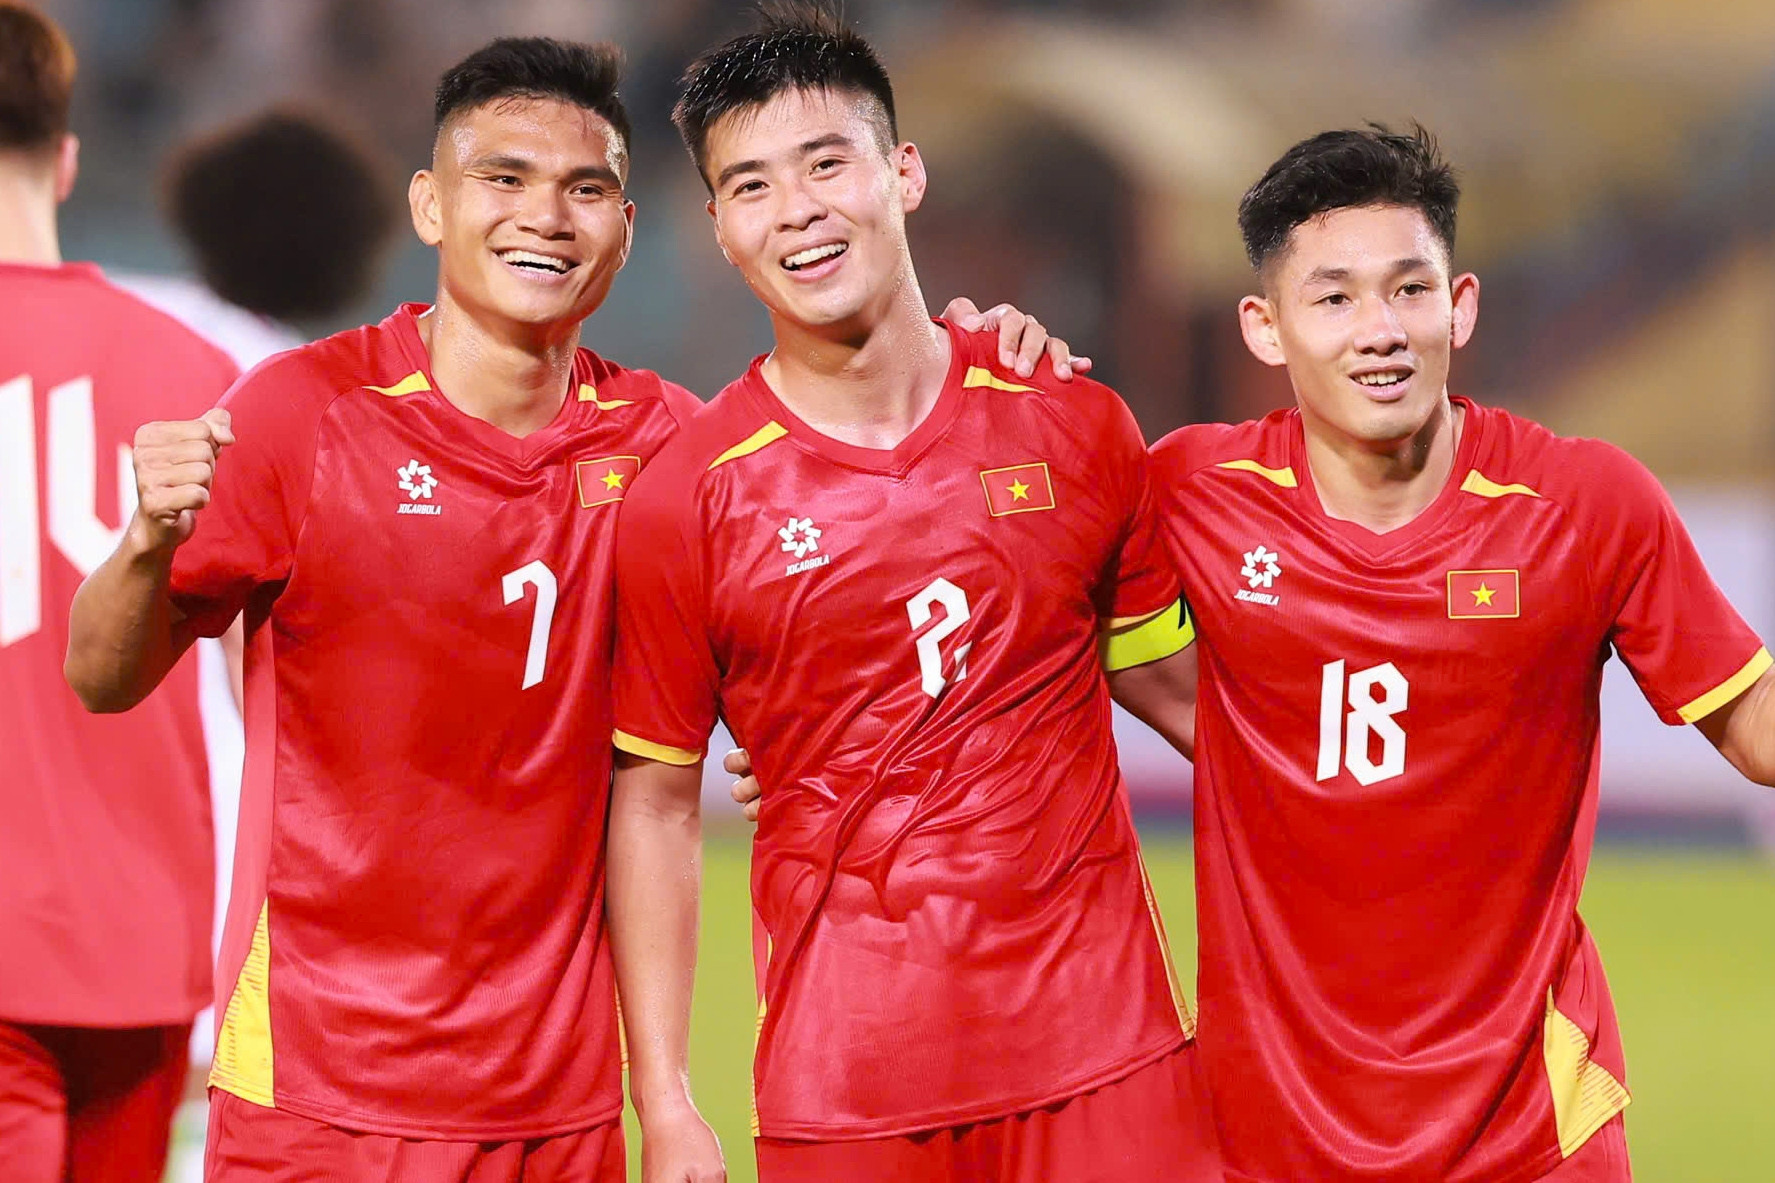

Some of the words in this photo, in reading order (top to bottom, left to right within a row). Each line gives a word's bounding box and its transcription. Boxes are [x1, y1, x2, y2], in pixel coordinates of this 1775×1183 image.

[502, 559, 558, 690] 7
[906, 577, 971, 699] 2
[1316, 658, 1409, 787] 18
